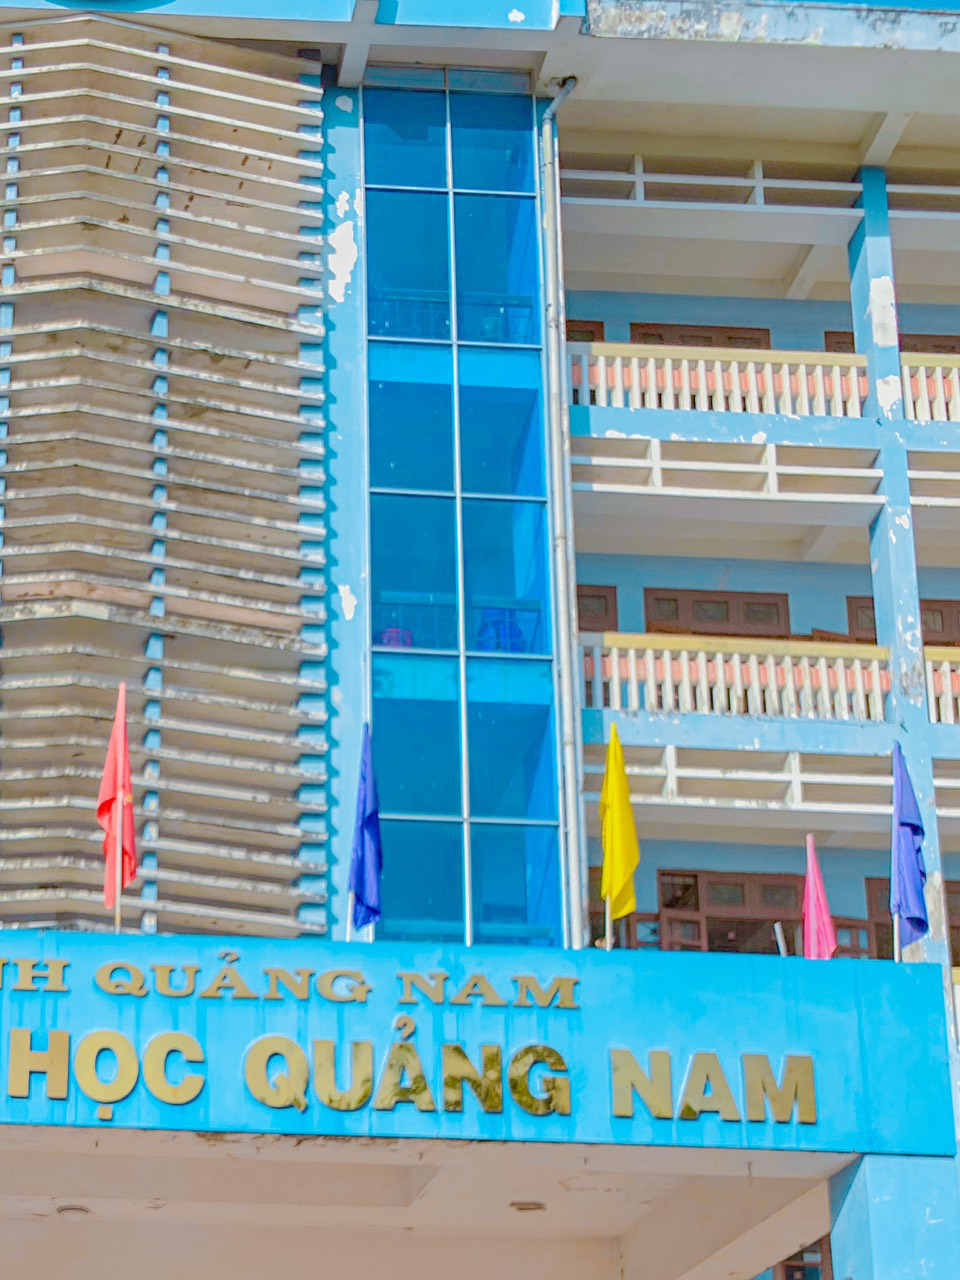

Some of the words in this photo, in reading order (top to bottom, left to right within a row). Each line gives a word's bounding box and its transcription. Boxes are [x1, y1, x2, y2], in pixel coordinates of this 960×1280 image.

[95, 951, 373, 1003] QUẢNG
[398, 972, 580, 1010] NAM
[7, 1026, 206, 1121] HỌC
[243, 1015, 572, 1117] QUẢNG
[610, 1047, 818, 1124] NAM
